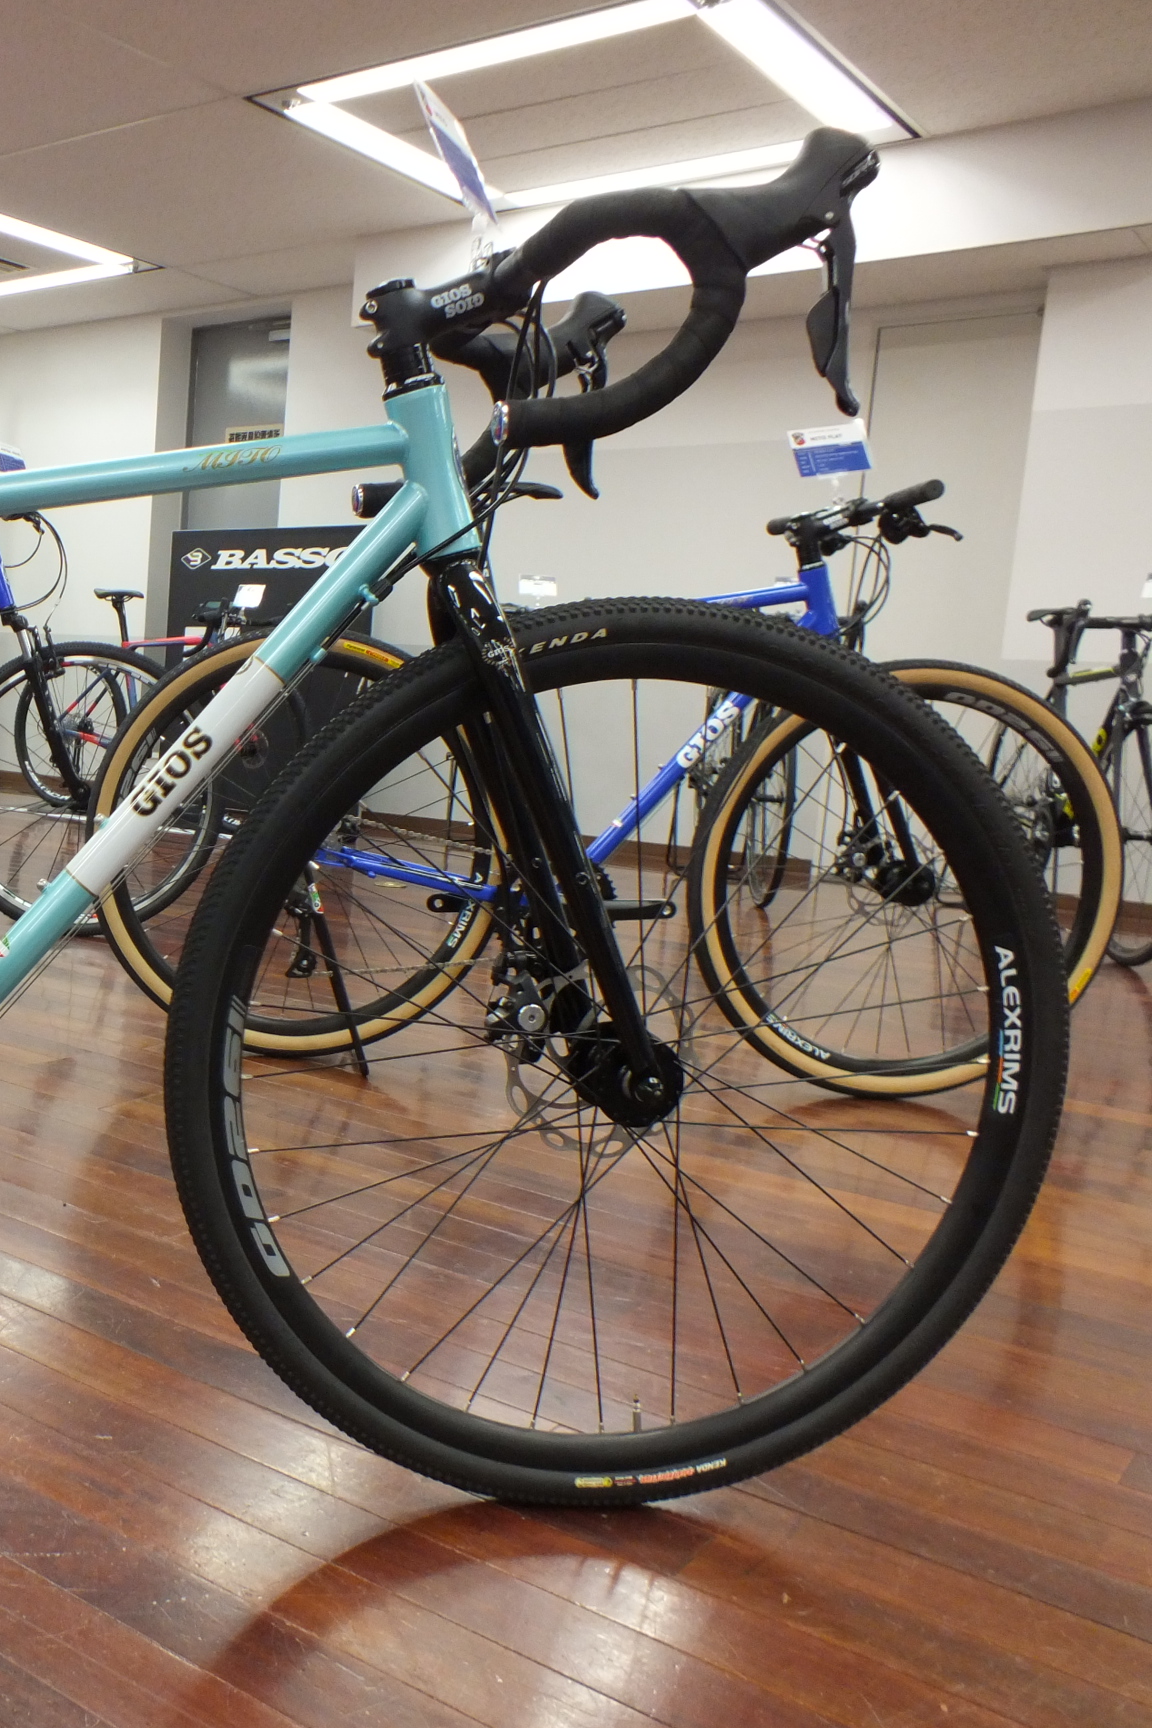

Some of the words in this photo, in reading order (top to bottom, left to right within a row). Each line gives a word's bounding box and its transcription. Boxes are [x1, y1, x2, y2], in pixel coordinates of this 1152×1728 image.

[431, 283, 472, 309] GIOS
[444, 292, 485, 319] GIOS
[182, 445, 283, 473] MITO
[517, 627, 609, 655] ENDA
[676, 699, 740, 768] GIOS
[130, 725, 213, 817] GIOS
[446, 871, 485, 948] AXRIMS
[765, 1012, 831, 1060] ALEXRIMS
[994, 945, 1023, 1115] ALEXRIMS
